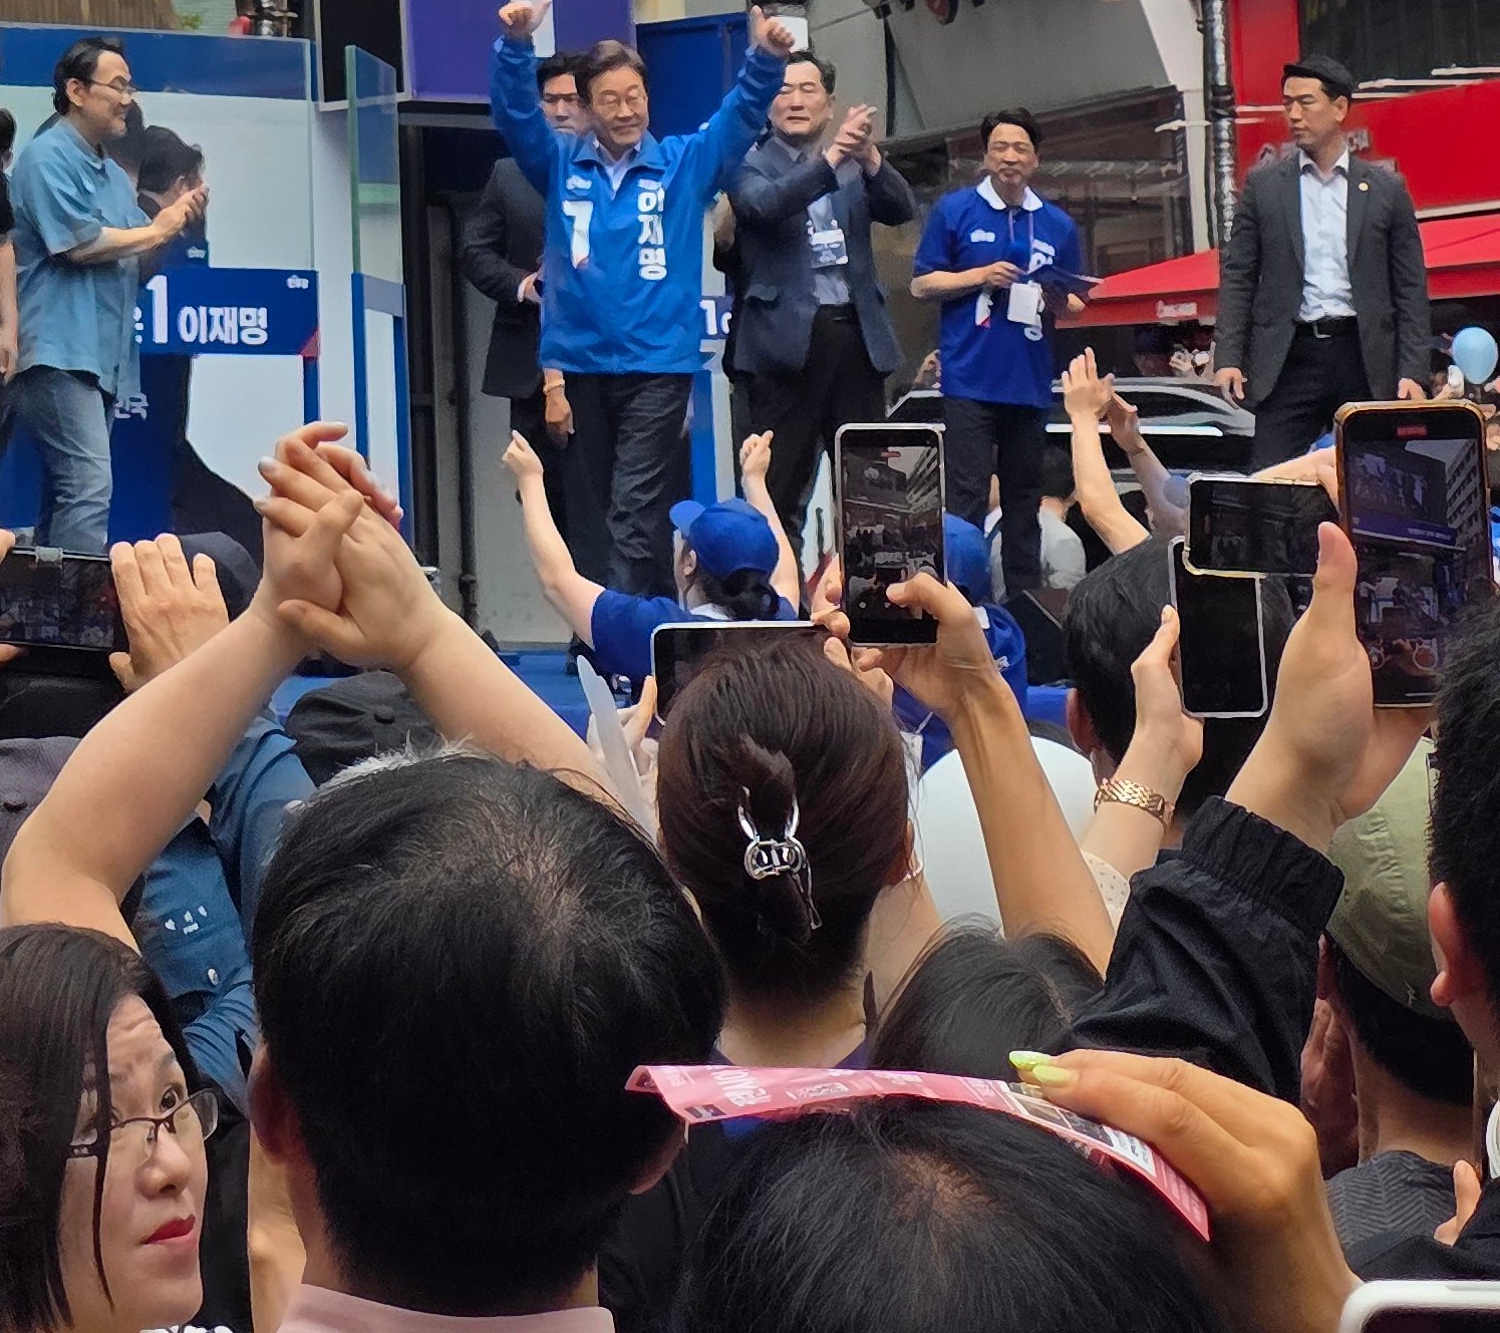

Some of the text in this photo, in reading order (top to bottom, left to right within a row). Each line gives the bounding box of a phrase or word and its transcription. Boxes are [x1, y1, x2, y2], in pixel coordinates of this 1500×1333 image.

[637, 188, 668, 281] 이재명
[145, 274, 169, 344] 1
[177, 305, 269, 345] 이재명
